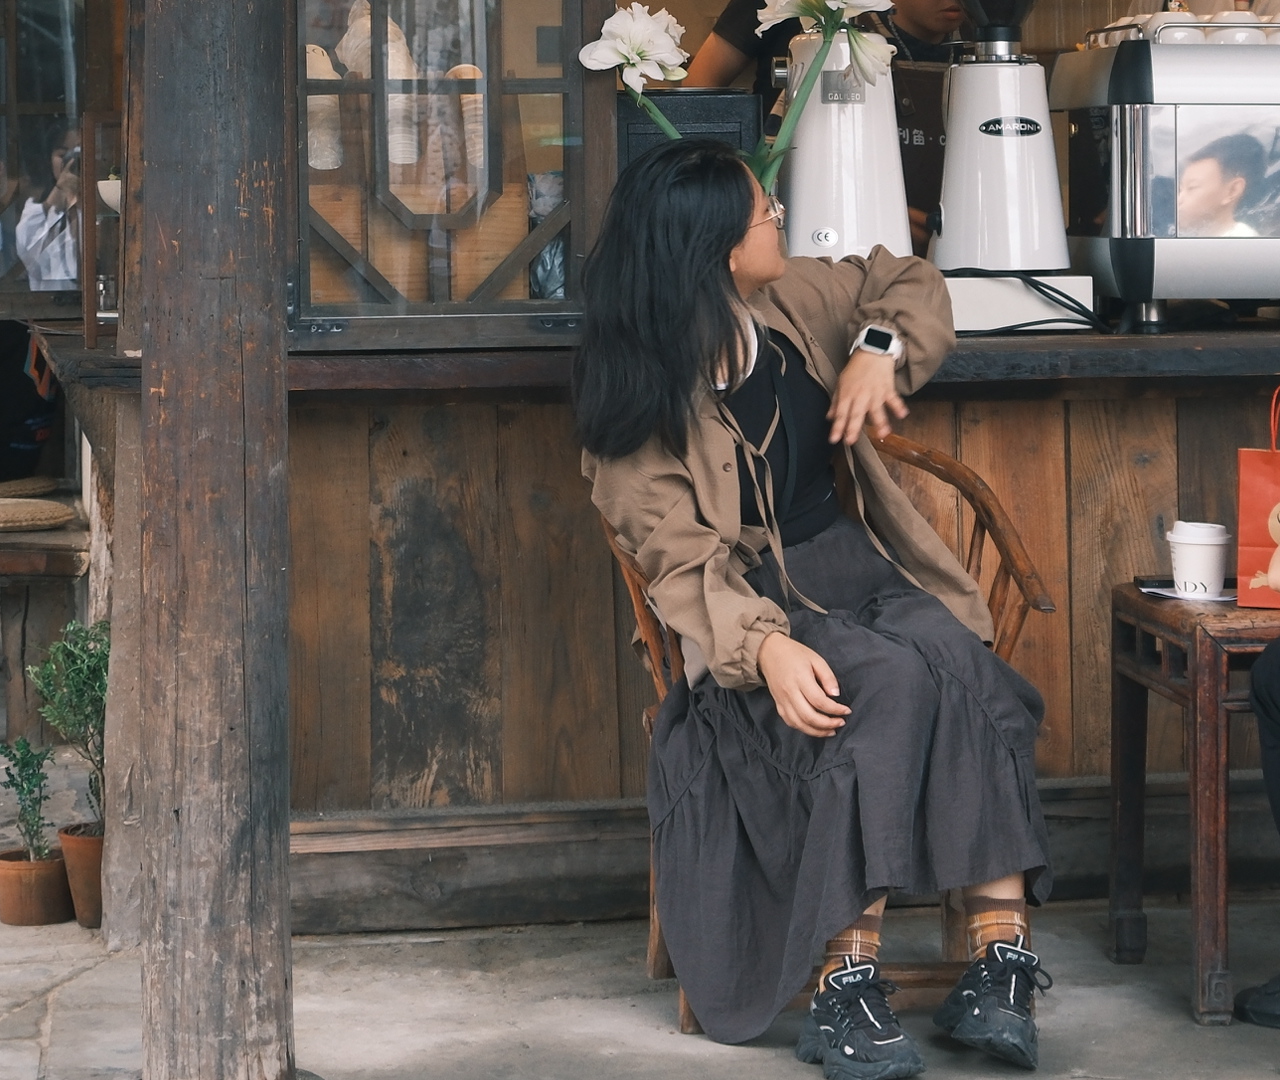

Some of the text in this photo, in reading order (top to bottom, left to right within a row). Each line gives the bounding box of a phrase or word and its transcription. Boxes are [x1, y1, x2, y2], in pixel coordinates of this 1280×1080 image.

[988, 123, 1037, 131] AMARONI
[817, 231, 830, 242] CE
[842, 973, 863, 985] FILA
